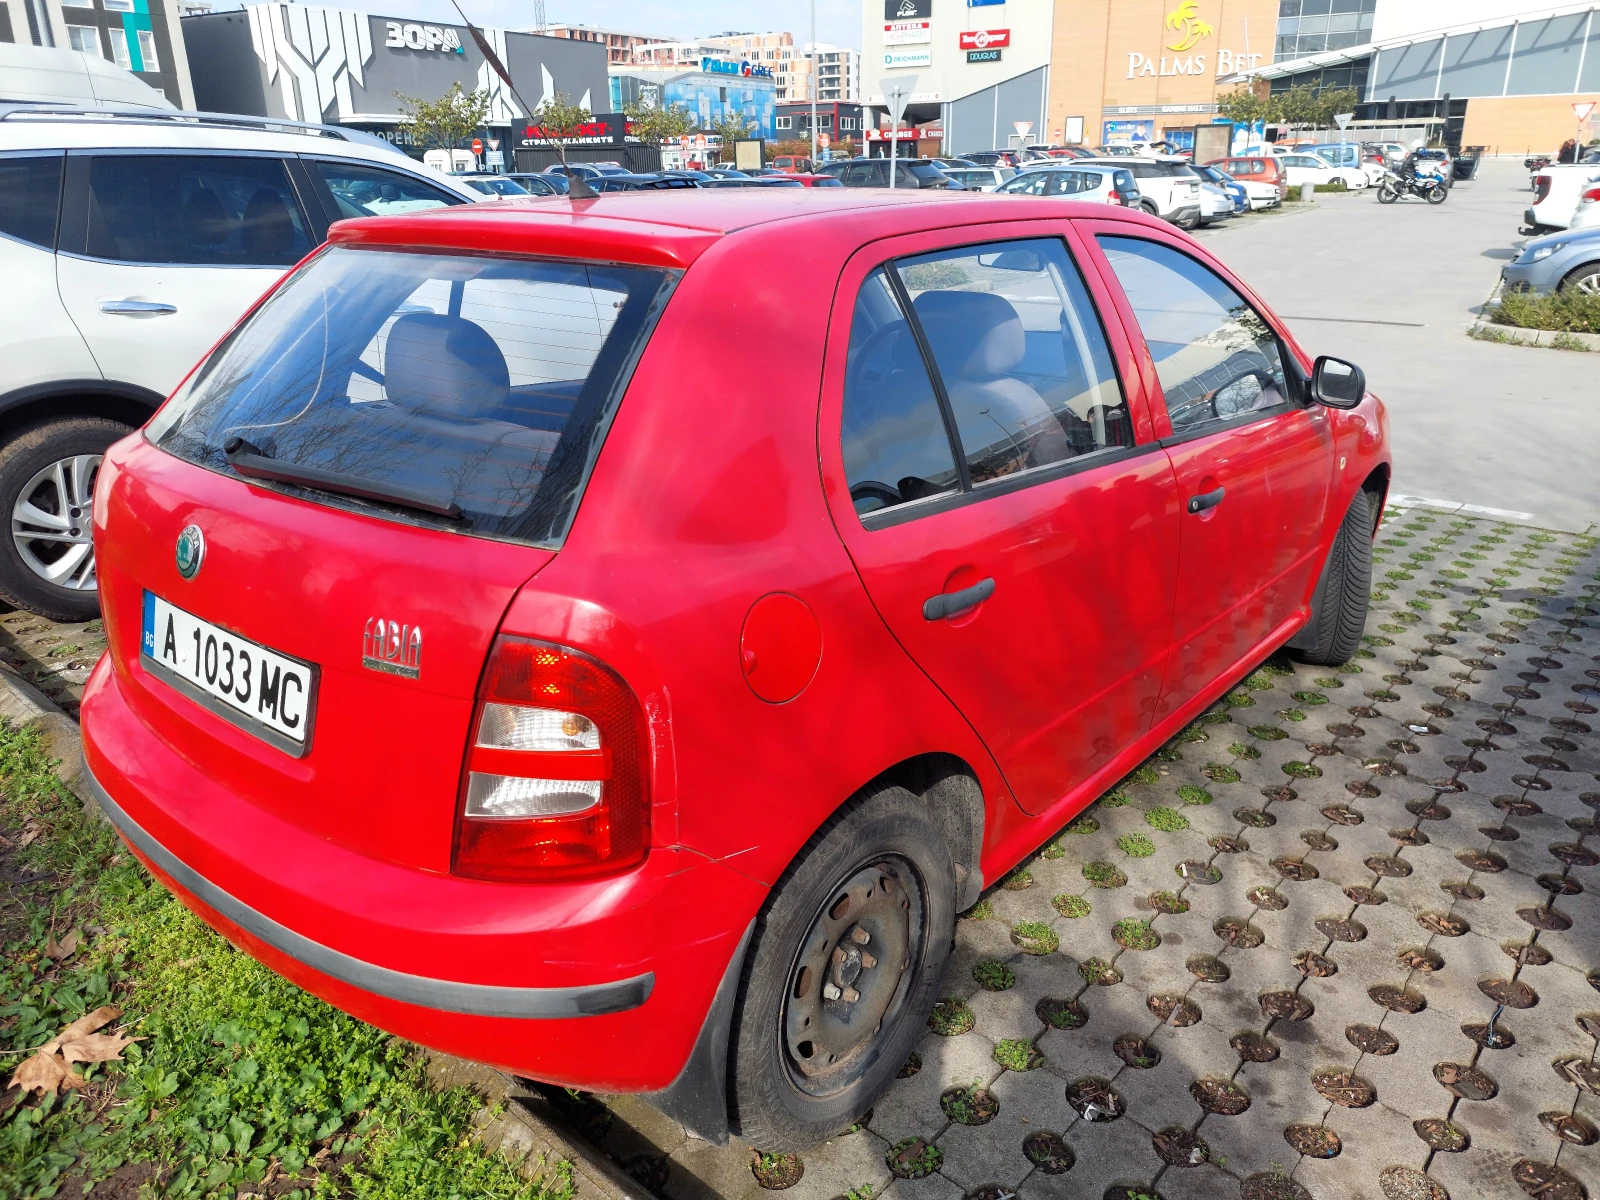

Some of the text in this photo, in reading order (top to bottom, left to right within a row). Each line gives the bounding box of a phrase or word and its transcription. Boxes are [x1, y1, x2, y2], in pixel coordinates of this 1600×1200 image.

[385, 22, 464, 54] ЗОРА
[890, 23, 923, 31] АПТЕКА
[970, 52, 997, 60] DOUGLAS
[1126, 52, 1206, 79] PALMS
[145, 631, 154, 647] BG
[363, 616, 422, 665] FABIA
[163, 613, 302, 729] A 1033 MC
